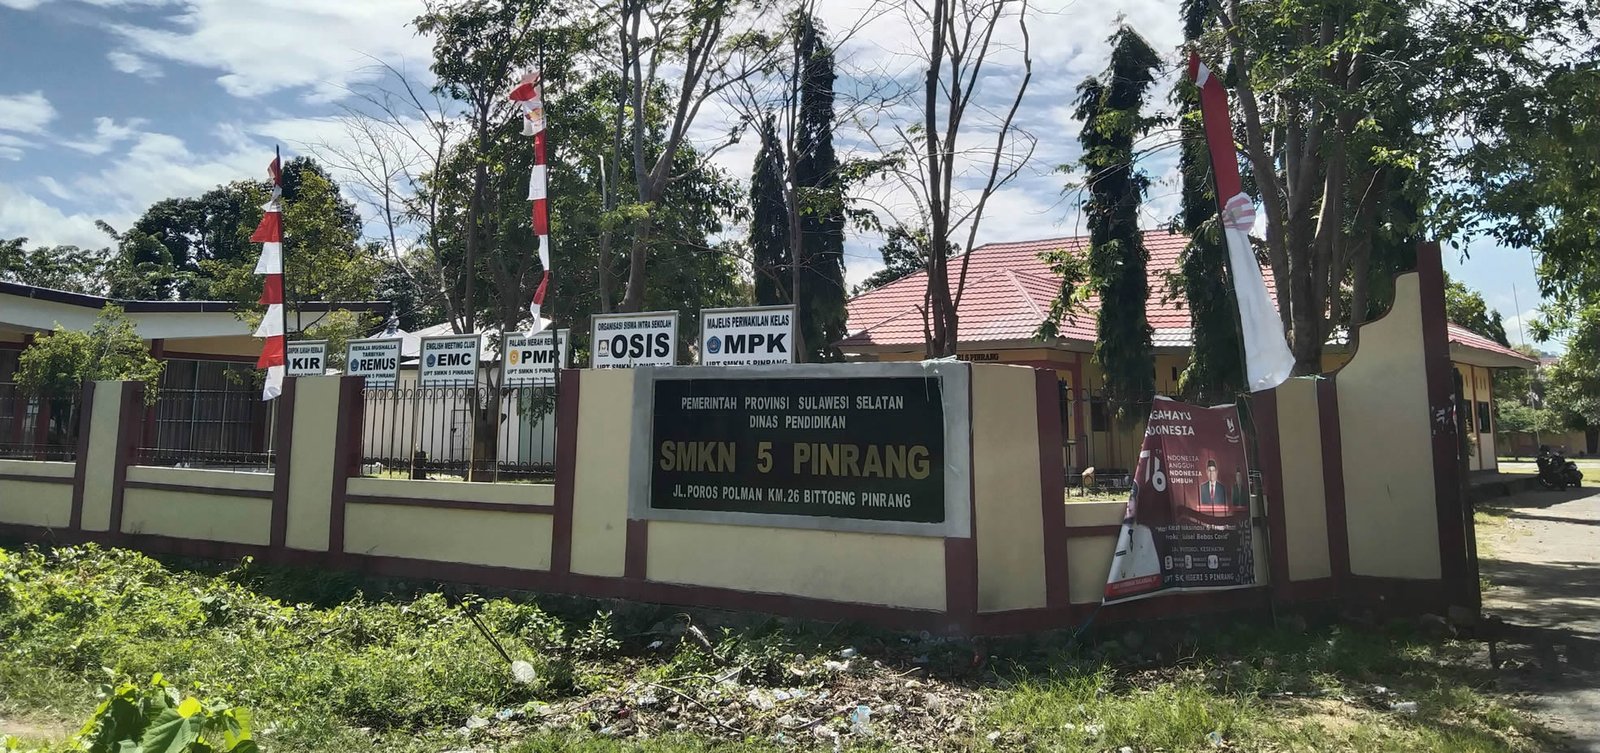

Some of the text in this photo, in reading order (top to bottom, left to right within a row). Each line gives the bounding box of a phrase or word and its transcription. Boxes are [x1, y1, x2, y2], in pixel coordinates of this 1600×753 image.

[597, 322, 623, 331] ORGANISASI
[638, 320, 651, 329] INTRA
[652, 319, 672, 328] SEKOLAH
[707, 314, 790, 329] MAJELIS PERWAKILAN KELAS
[426, 342, 444, 350] ENGLISH
[444, 341, 463, 349] MEETING
[509, 339, 527, 347] PALANG
[527, 338, 544, 346] MERAH
[611, 332, 670, 358] OSIS
[724, 333, 787, 354] MPK
[292, 357, 320, 370] KIR
[437, 353, 472, 367] EMC
[521, 350, 561, 364] PMR
[360, 358, 396, 371] REMUS
[681, 396, 904, 410] PEMERINTAH PROVINSI SULAWESI SELATAN
[749, 415, 846, 429] DINAS PENDIDIKAN
[660, 440, 930, 480] SMKN 5 PINRANG
[672, 484, 911, 508] JL.POROS POLMAN KM.26 BITTOENG PINRANG
